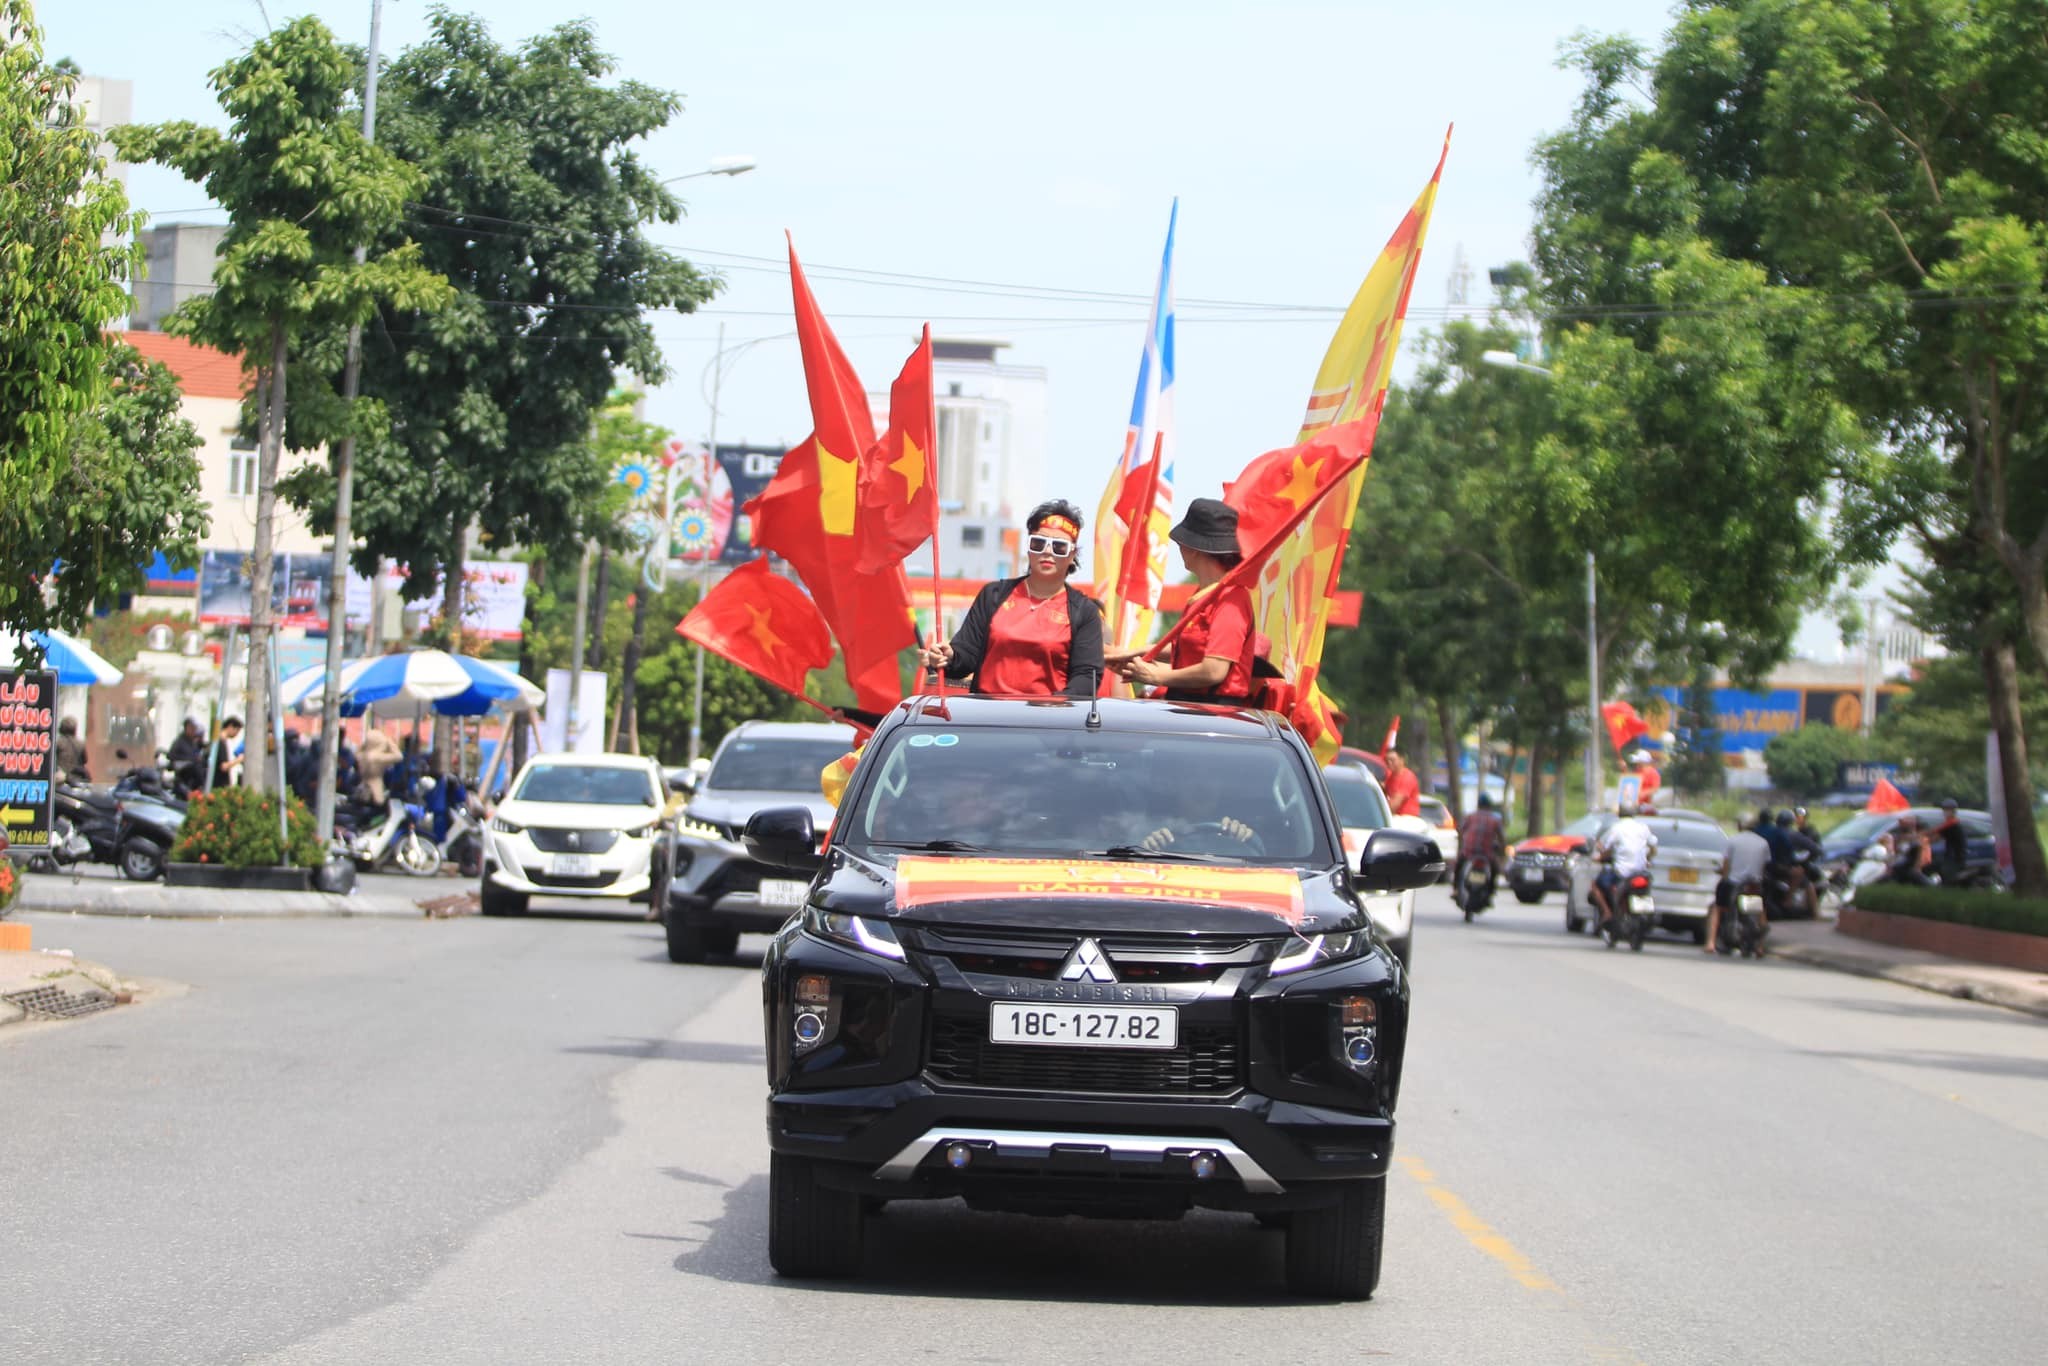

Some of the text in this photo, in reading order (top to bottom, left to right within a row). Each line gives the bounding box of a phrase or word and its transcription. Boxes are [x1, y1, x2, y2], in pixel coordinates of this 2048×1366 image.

[0, 703, 52, 727] ƯỚNG
[0, 727, 51, 750] HÙNG
[0, 779, 49, 802] UFFET
[1008, 983, 1168, 1000] MITSUBISHI
[1011, 1012, 1160, 1039] 18C-127.82
